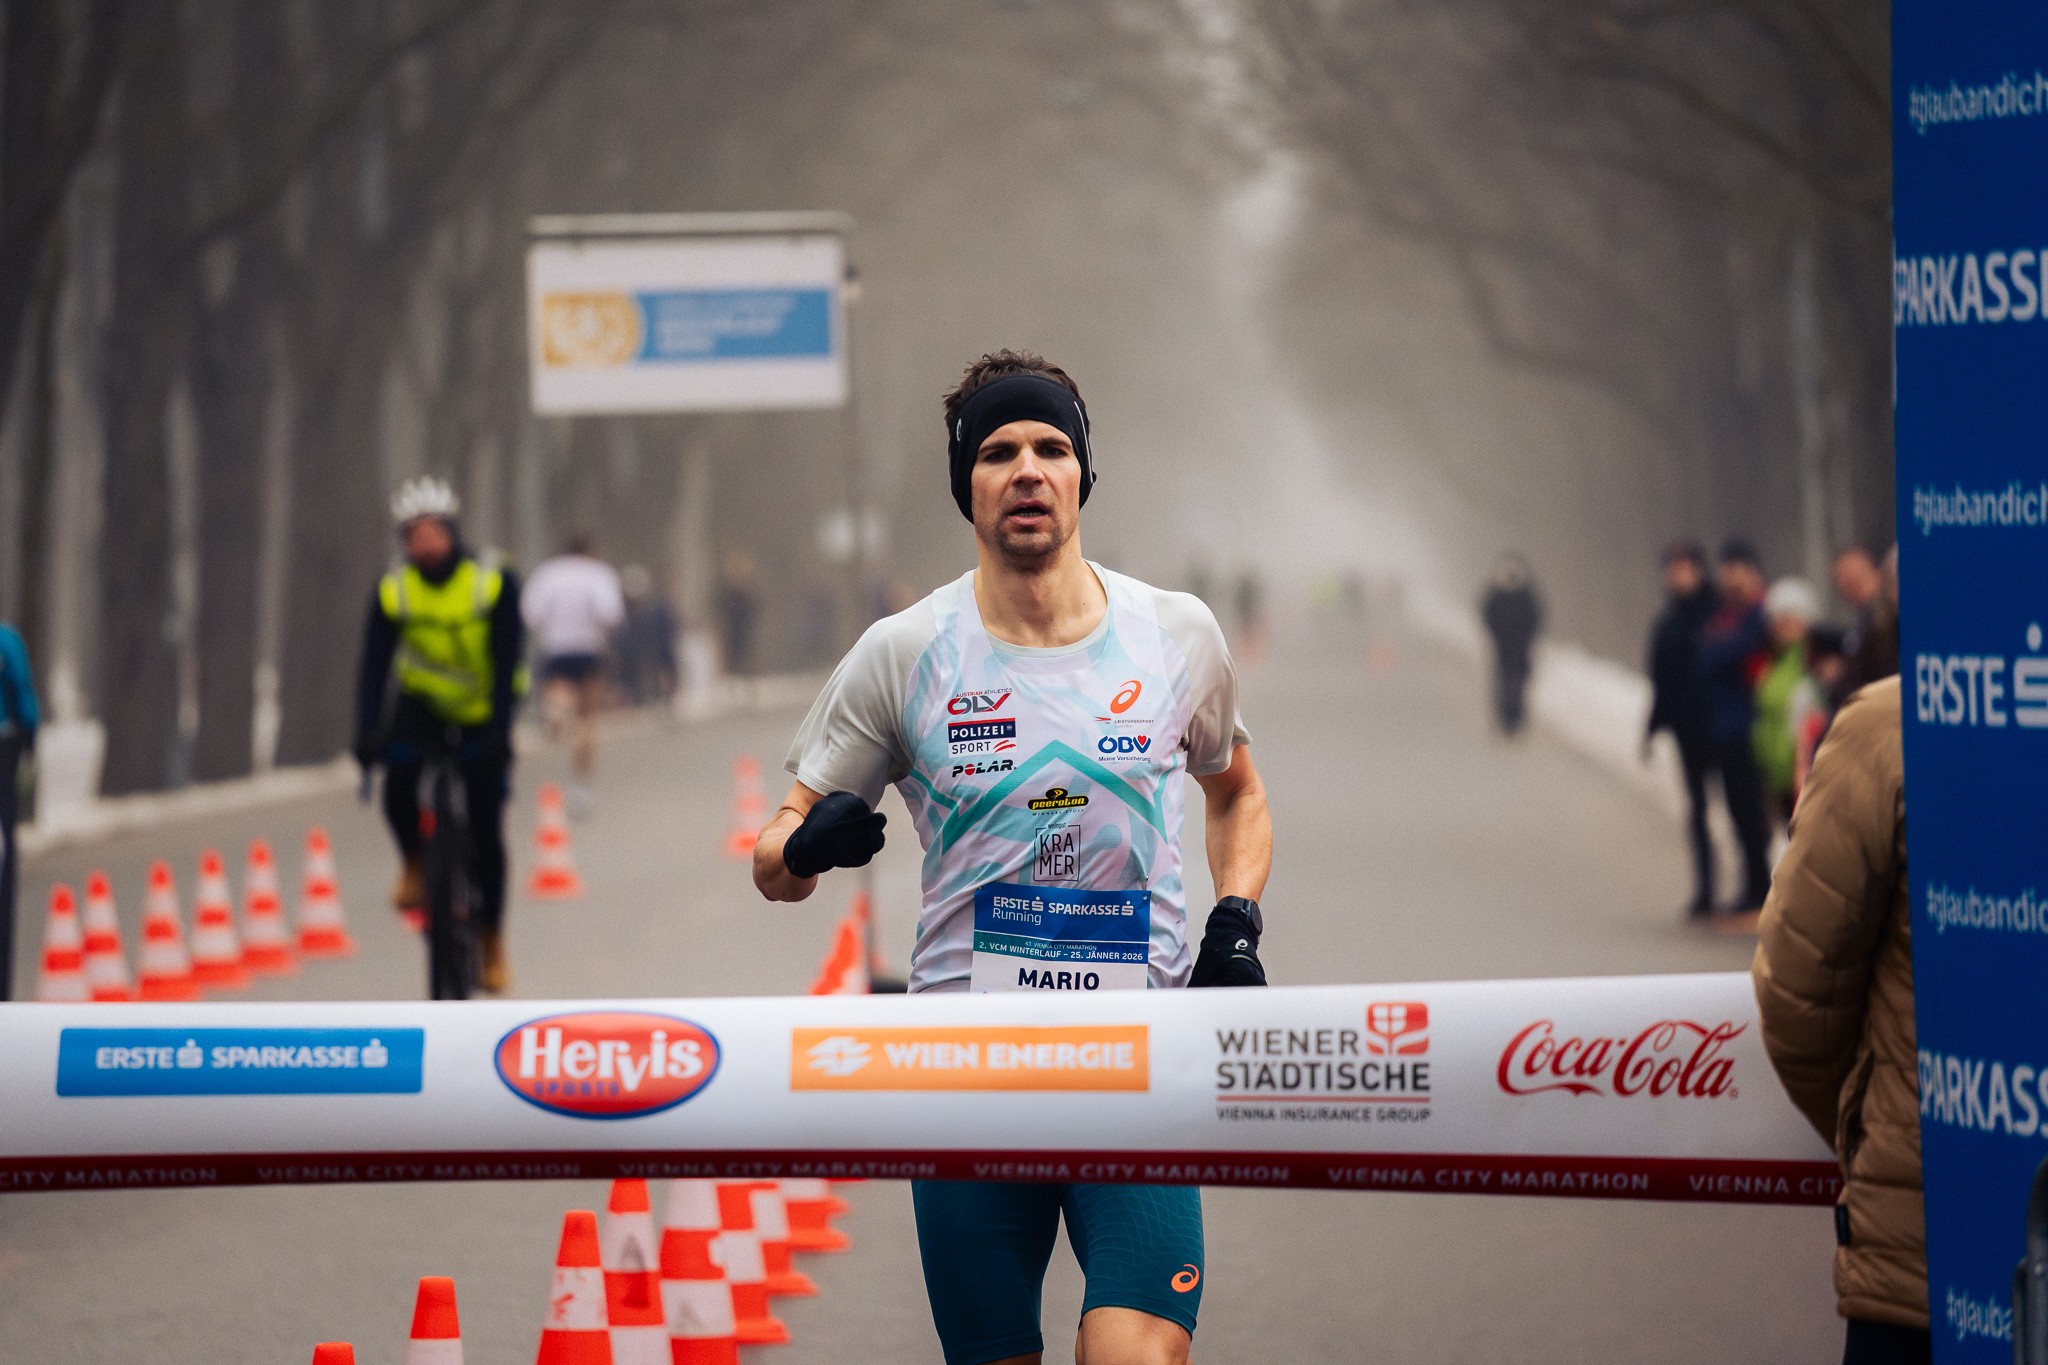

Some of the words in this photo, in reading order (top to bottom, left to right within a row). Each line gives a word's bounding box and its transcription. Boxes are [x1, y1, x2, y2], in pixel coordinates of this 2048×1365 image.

[955, 690, 983, 698] AUSTRIAN
[984, 687, 1013, 695] ATHLETICS
[1916, 654, 2007, 727] ERSTE
[951, 725, 1004, 739] POLIZEI
[952, 741, 991, 755] SPORT
[952, 759, 1014, 778] POLAR
[1117, 755, 1151, 763] Versicherung
[1032, 797, 1085, 811] peeroton
[1040, 833, 1074, 855] KRA
[1040, 855, 1074, 876] MER
[993, 896, 1030, 911] ERSTE
[1048, 902, 1120, 916] SPARKASSE
[993, 908, 1042, 926] Running
[979, 941, 987, 949] 2.
[989, 942, 1007, 952] VCM
[1009, 944, 1062, 959] WINTERLAUF
[1070, 951, 1084, 959] 25.
[1086, 949, 1120, 960] JÄNNER
[1122, 952, 1143, 961] 2026
[1018, 967, 1099, 990] MARIO
[1216, 1029, 1359, 1056] WIENER
[95, 1046, 175, 1069] ERSTE
[210, 1046, 360, 1069] SPARKASSE
[518, 1027, 703, 1092] Hervis
[884, 1042, 979, 1070] WIEN
[987, 1041, 1135, 1070] ENERGIE
[1496, 1018, 1749, 1099] Coca-Cola
[1216, 1061, 1431, 1092] STÄDTISCHE
[534, 1080, 620, 1097] SPORTS
[1216, 1106, 1275, 1122] VIENNA
[1280, 1106, 1371, 1123] INSURANCE
[1376, 1107, 1431, 1123] GROUP
[65, 1168, 217, 1186] MARATHON
[257, 1165, 357, 1181] VIENNA
[366, 1164, 426, 1180] CITY
[434, 1162, 580, 1179] MARATHON
[620, 1162, 718, 1178] VIENNA
[725, 1162, 782, 1177] CITY
[791, 1162, 936, 1177] MARATHON
[973, 1162, 1071, 1179] VIENNA
[1079, 1163, 1136, 1180] CITY
[1144, 1164, 1289, 1183] MARATHON
[1328, 1167, 1425, 1185] VIENNA
[1435, 1168, 1493, 1187] CITY
[1500, 1169, 1649, 1192] MARATHON
[1689, 1174, 1790, 1195] VIENNA
[1800, 1176, 1847, 1197] CIT
